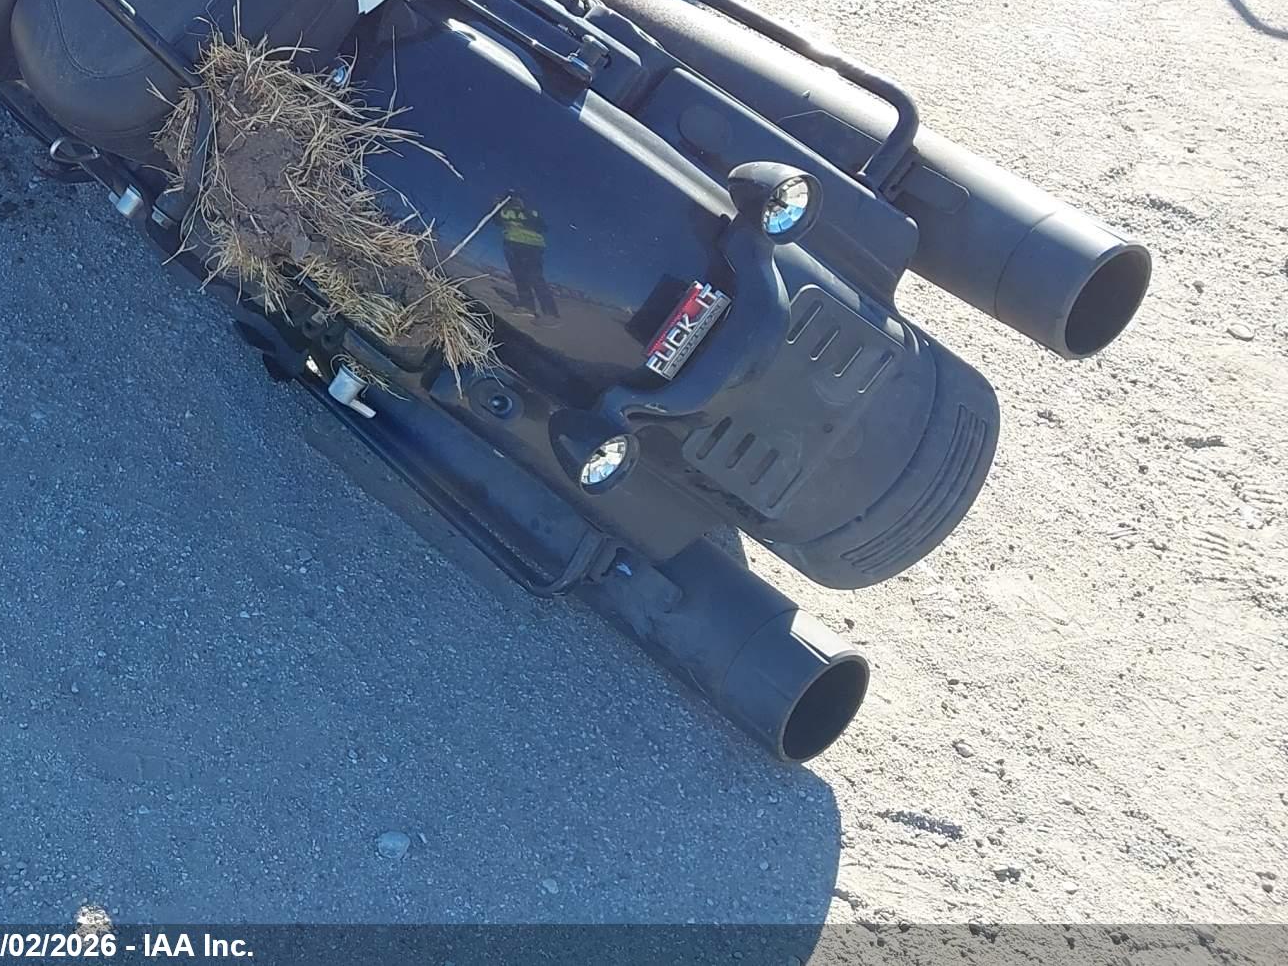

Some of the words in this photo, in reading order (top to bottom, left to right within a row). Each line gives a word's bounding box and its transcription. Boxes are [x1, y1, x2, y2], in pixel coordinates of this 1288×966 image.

[645, 313, 699, 374] FUCK
[695, 283, 717, 309] IT
[670, 303, 724, 369] EDITION
